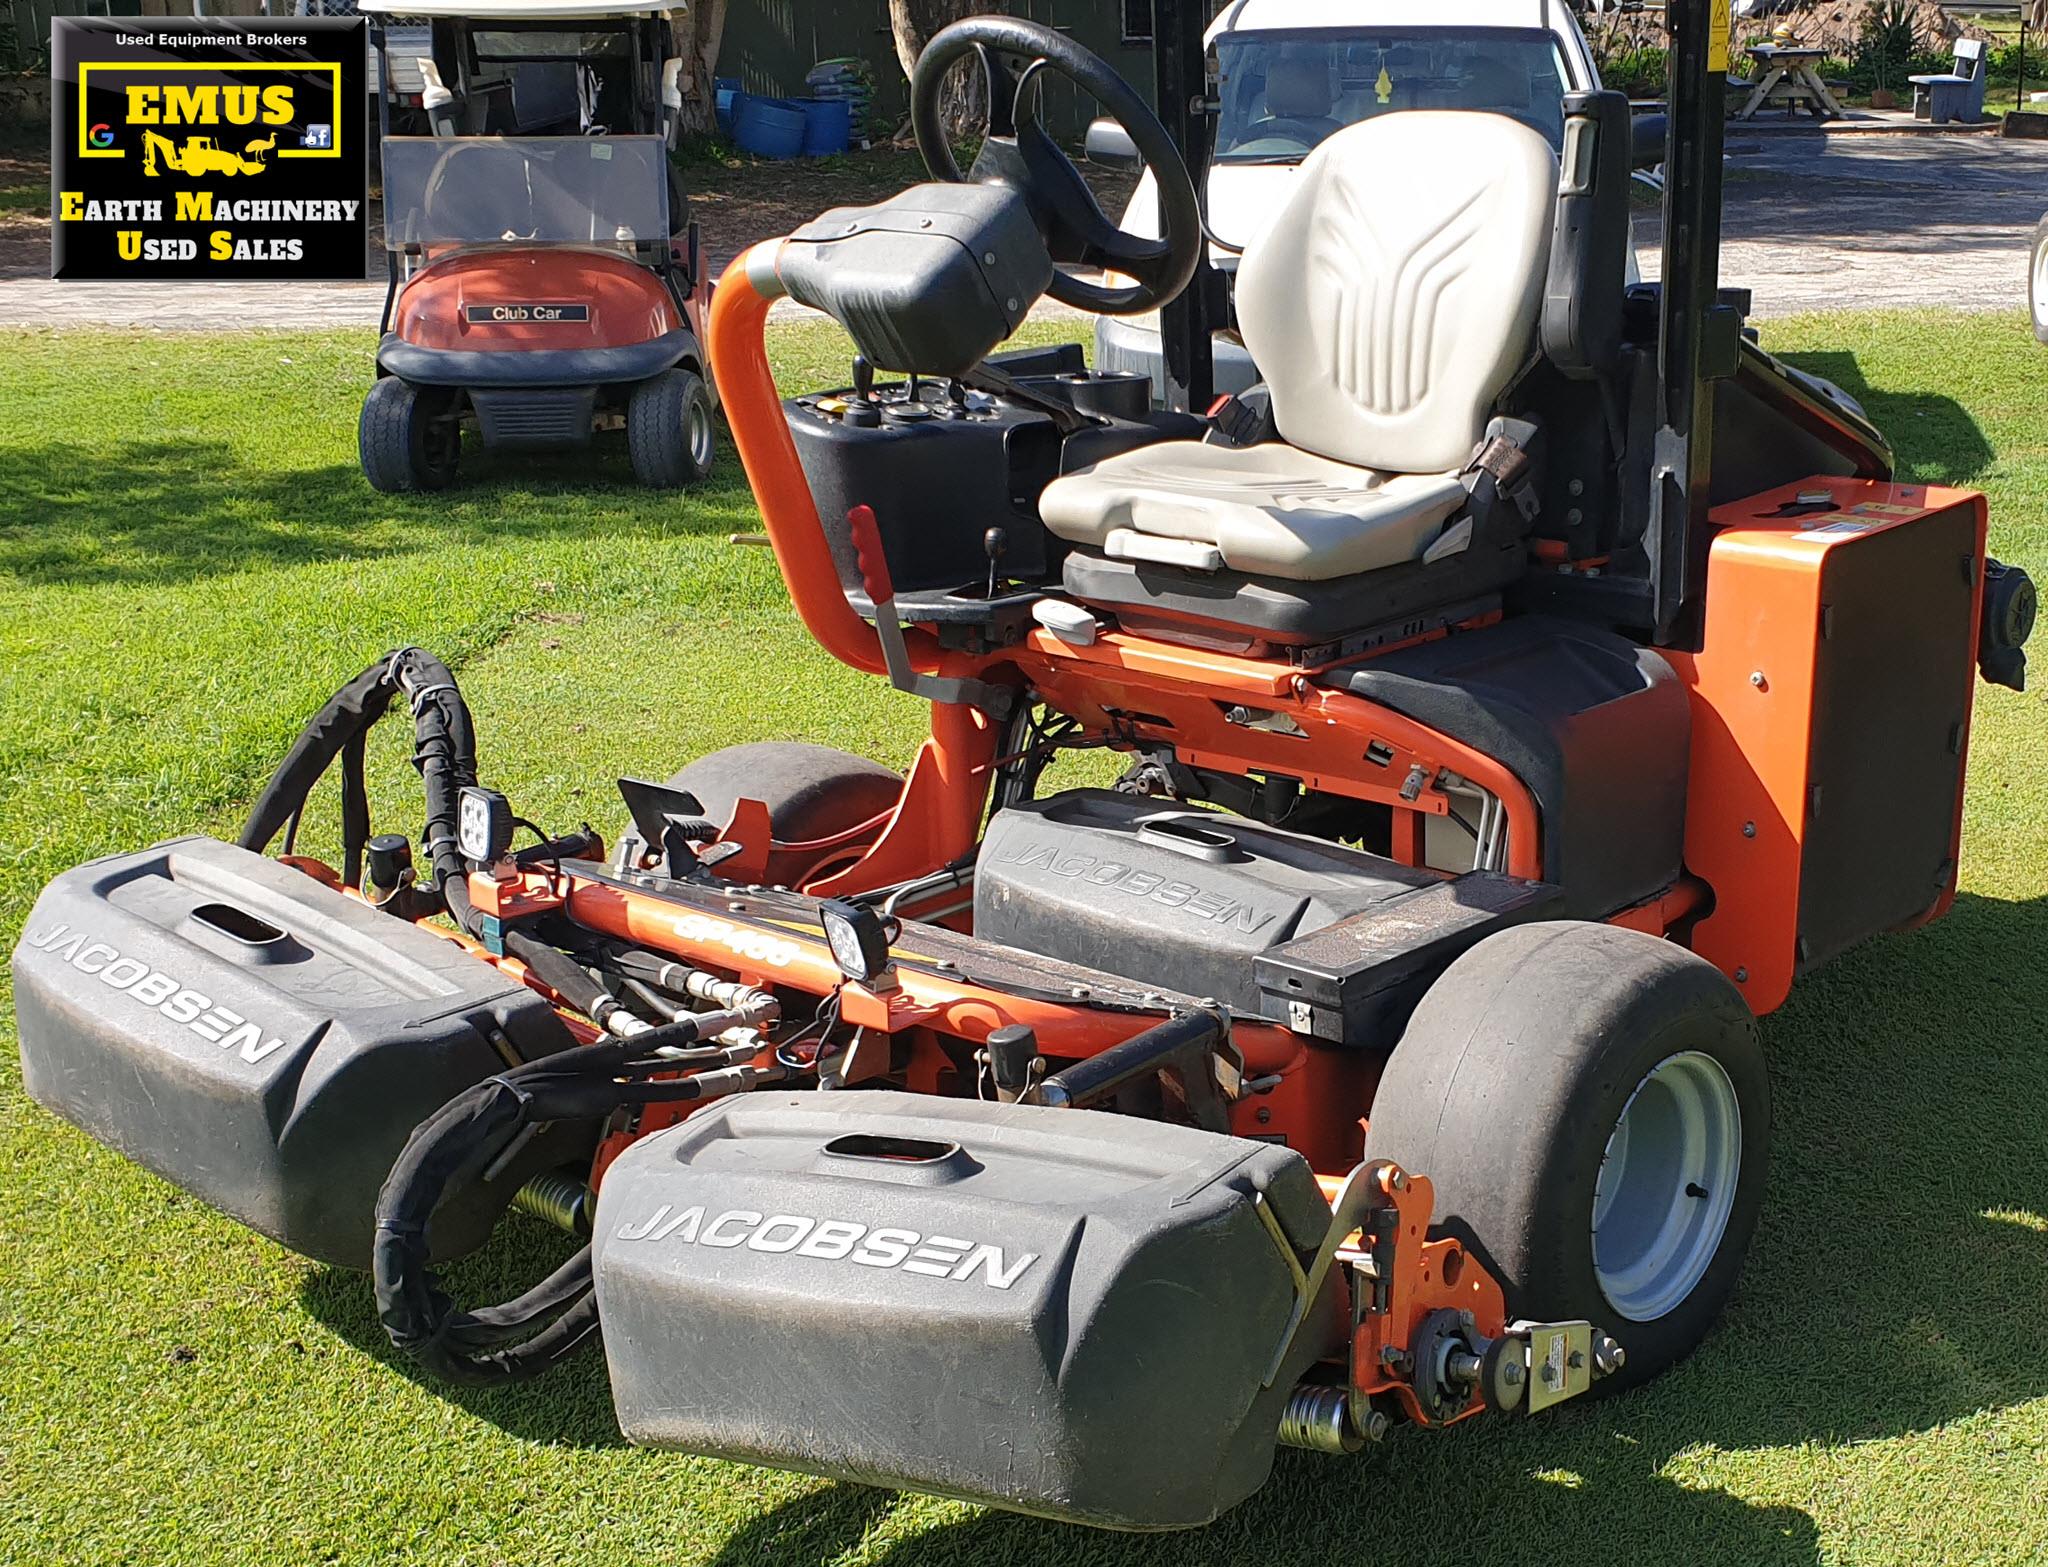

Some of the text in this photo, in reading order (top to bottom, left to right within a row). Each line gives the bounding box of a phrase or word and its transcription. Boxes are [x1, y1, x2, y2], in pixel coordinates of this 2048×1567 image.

[492, 306, 562, 321] Club Car
[1000, 843, 1277, 934] JACOBSEN
[27, 923, 286, 1064] JACOBSEN
[616, 1204, 1040, 1290] JACOBSEN
